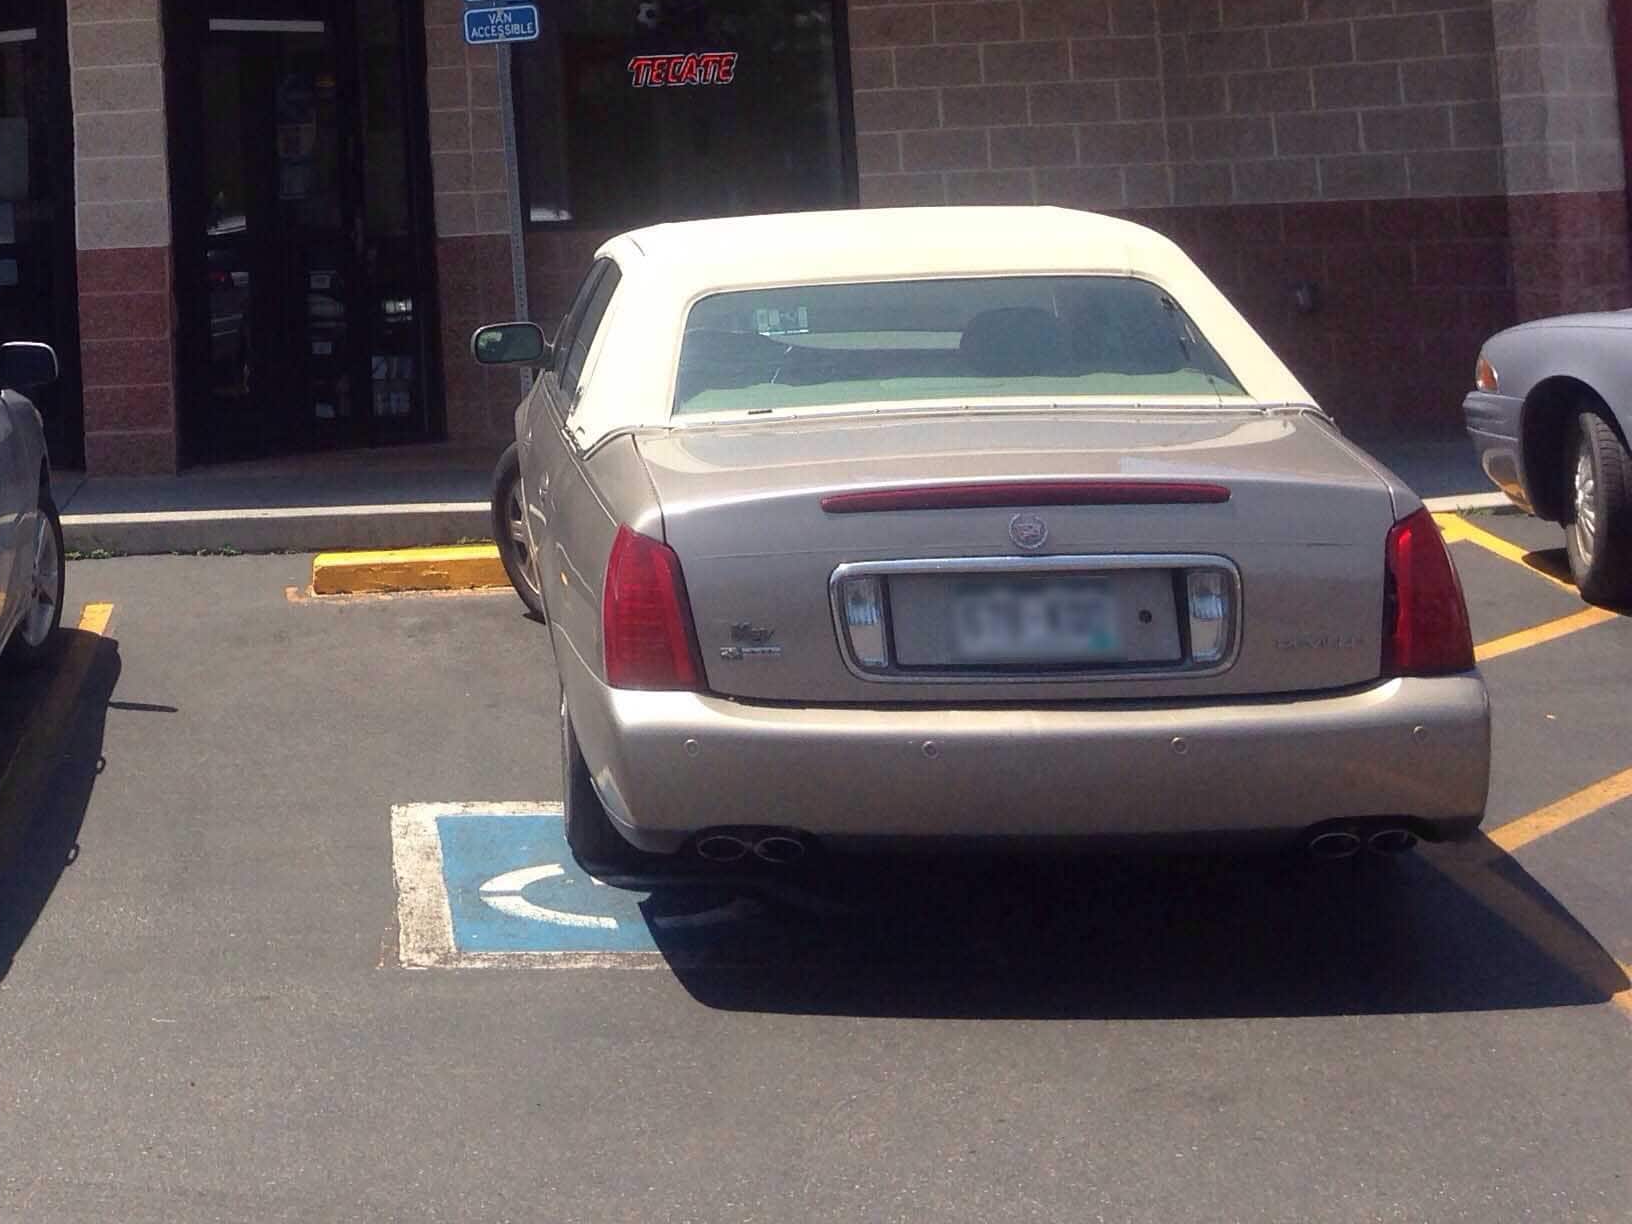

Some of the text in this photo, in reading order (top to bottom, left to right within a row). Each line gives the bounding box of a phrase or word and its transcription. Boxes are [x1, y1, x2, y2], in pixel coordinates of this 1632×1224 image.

[488, 11, 512, 24] VAN
[471, 23, 534, 38] ACCESSIBLE
[628, 52, 738, 87] TECATE
